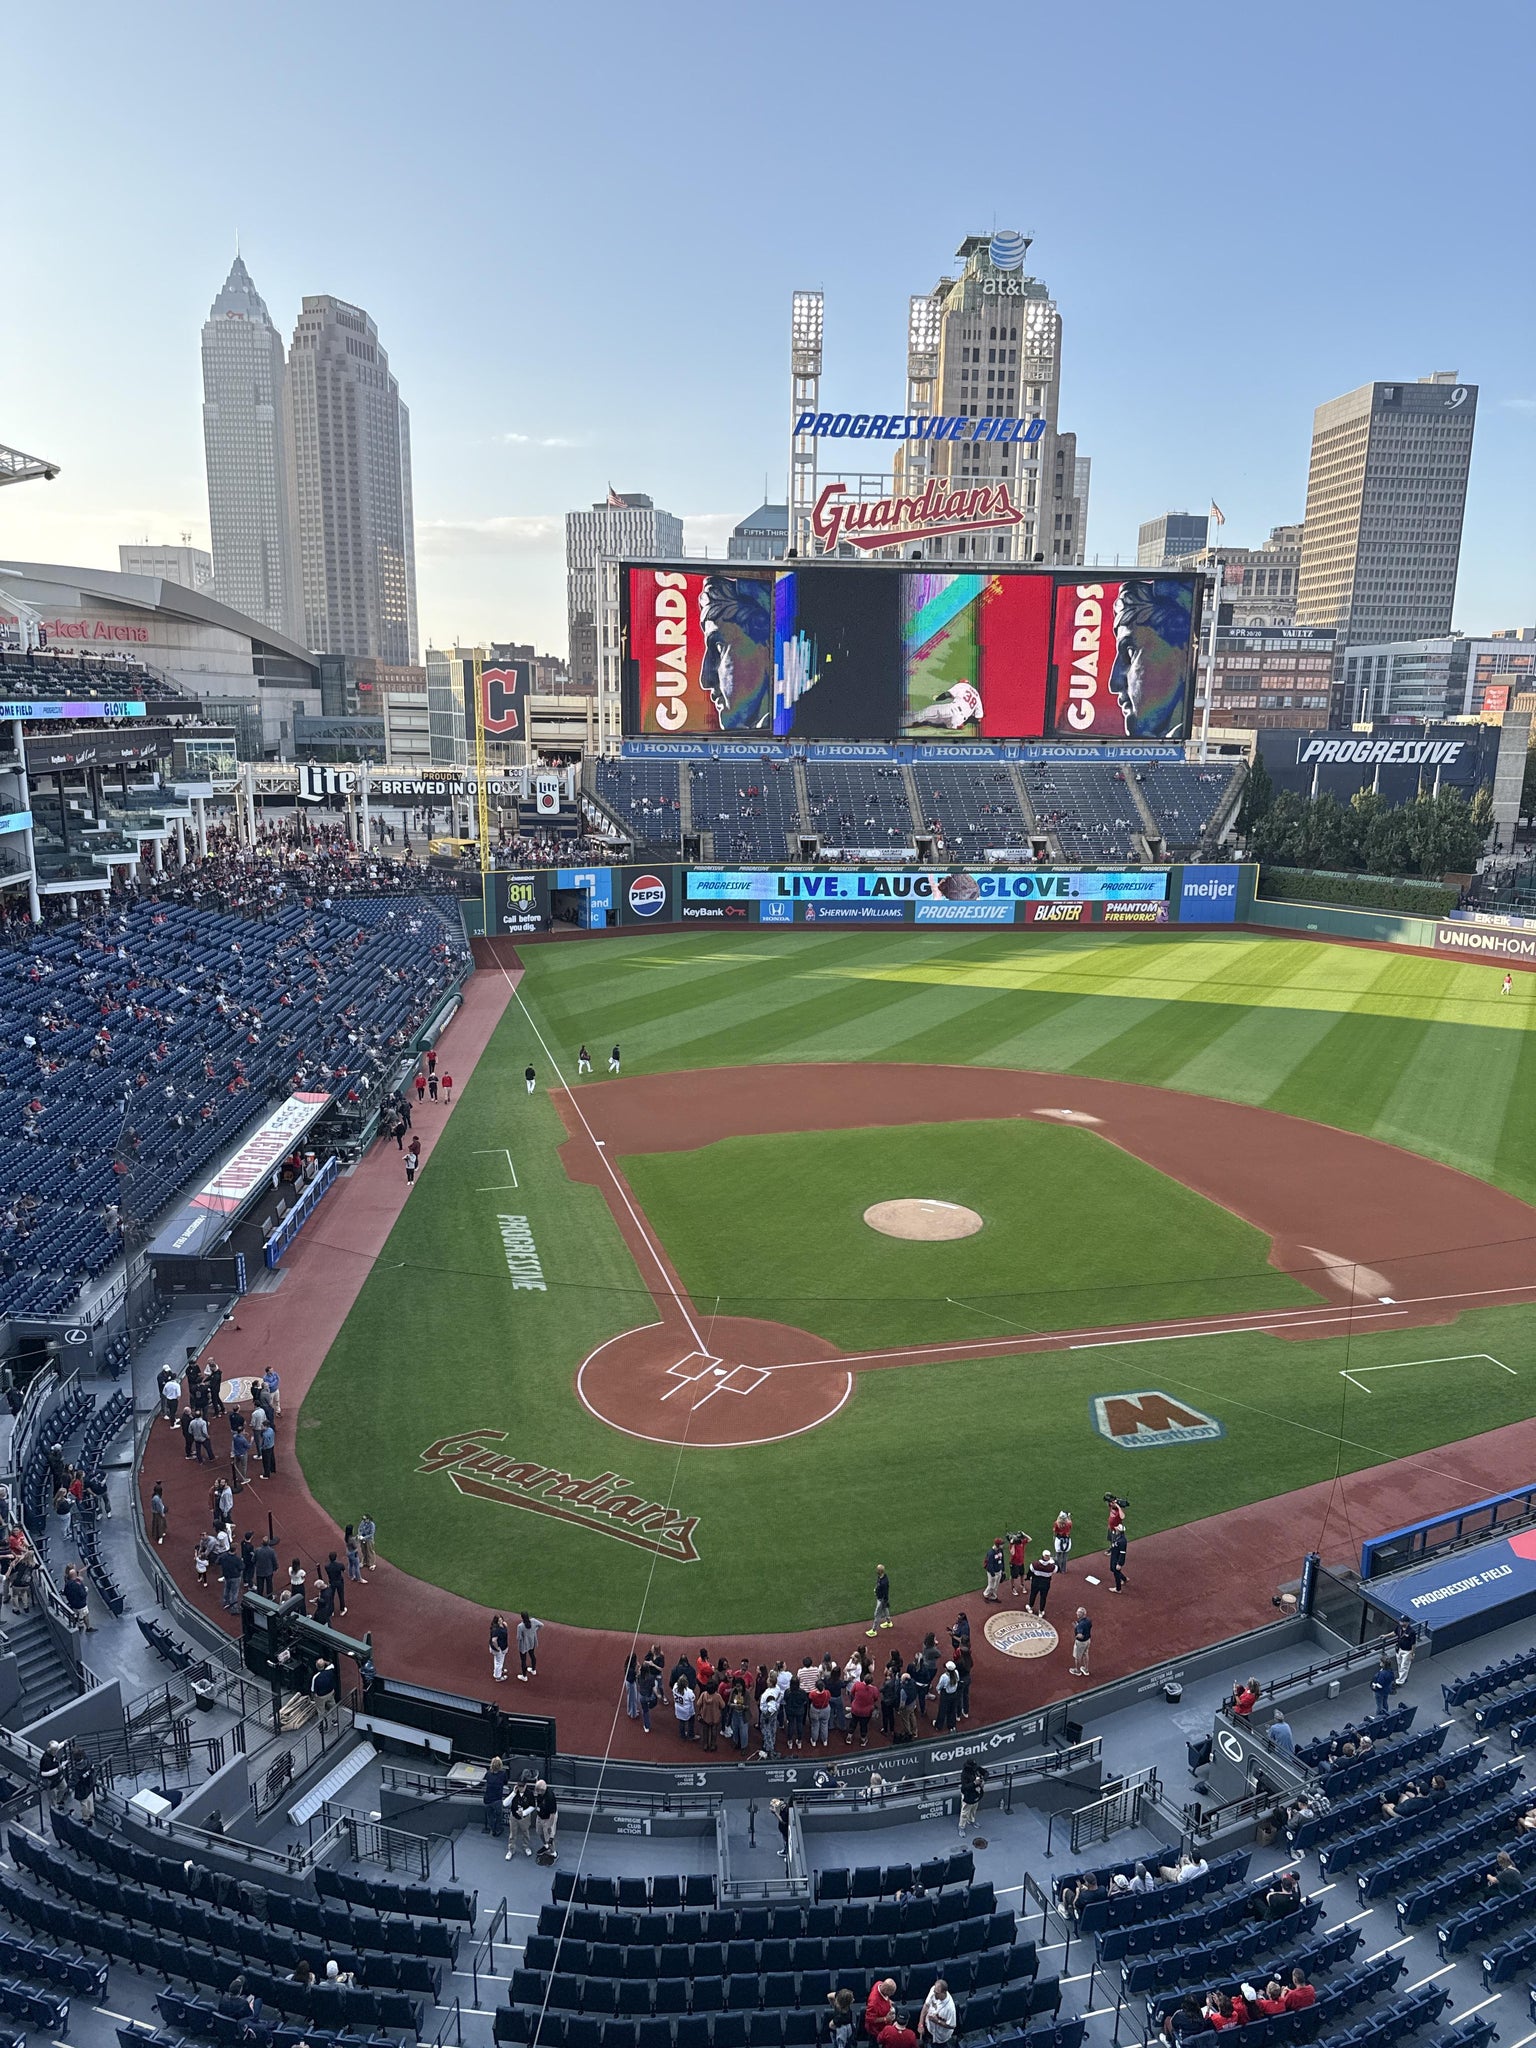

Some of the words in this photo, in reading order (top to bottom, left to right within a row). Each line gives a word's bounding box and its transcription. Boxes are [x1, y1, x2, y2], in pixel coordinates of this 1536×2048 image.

[982, 276, 1028, 296] at&t
[1448, 387, 1468, 410] 9
[793, 412, 969, 440] PROGRESSIVE
[971, 417, 1047, 442] FIELD
[811, 477, 1025, 555] Guardians
[743, 528, 765, 536] FIFTH
[94, 620, 149, 642] Arena
[1281, 629, 1315, 638] VAULTZ
[655, 571, 688, 731] GUARDS
[1067, 584, 1104, 730] GUARDS
[481, 667, 518, 734] C
[963, 690, 977, 710] 38
[16, 705, 33, 716] FIELD
[104, 702, 131, 716] GLOVE.
[643, 743, 704, 754] HONDA
[723, 744, 783, 755] HONDA
[828, 745, 889, 756] HONDA
[936, 747, 996, 757] HONDA
[1042, 747, 1100, 757] HONDA
[1119, 747, 1178, 757] HONDA
[1301, 740, 1465, 764] PROGRESSIVE
[296, 764, 357, 802] Lite
[423, 772, 462, 781] PROUDLY
[382, 781, 445, 794] BREWED
[449, 782, 463, 794] IN
[467, 782, 501, 795] OIO
[538, 782, 558, 794] Lite
[697, 881, 752, 890] PROGRESSIVE
[777, 876, 848, 897] LIVE.
[857, 876, 934, 898] LAUG
[978, 876, 1080, 898] GLOVE.
[1100, 882, 1155, 891] PROGRESSIVE
[1183, 879, 1235, 900] meijer
[510, 884, 532, 902] 811
[631, 890, 664, 901] PEPSI
[683, 907, 724, 917] KeyBank
[917, 905, 1007, 919] PROGRESSIVE
[1034, 904, 1083, 921] BLASTER
[1106, 903, 1158, 912] PHANTOM
[503, 915, 517, 923] Call
[519, 914, 542, 923] before
[1104, 913, 1157, 922] FIREWORKS
[509, 925, 522, 933] you
[212, 1130, 294, 1190] CLEVELAND
[496, 1214, 548, 1291] PROGRESSIVE
[1120, 1426, 1219, 1446] Marathon
[413, 1428, 702, 1564] Guardians
[1410, 1574, 1483, 1609] PROGRESSIVE
[1480, 1563, 1514, 1583] FIELD
[1038, 1717, 1044, 1731] 1
[931, 1742, 988, 1763] KeyBank
[878, 1756, 919, 1770] MUTUAL
[696, 1772, 707, 1787] 3
[786, 1769, 798, 1783] 2
[945, 1798, 953, 1815] 1
[113, 1813, 123, 1832] 2
[643, 1819, 652, 1836] 1
[617, 1827, 642, 1835] SECTION
